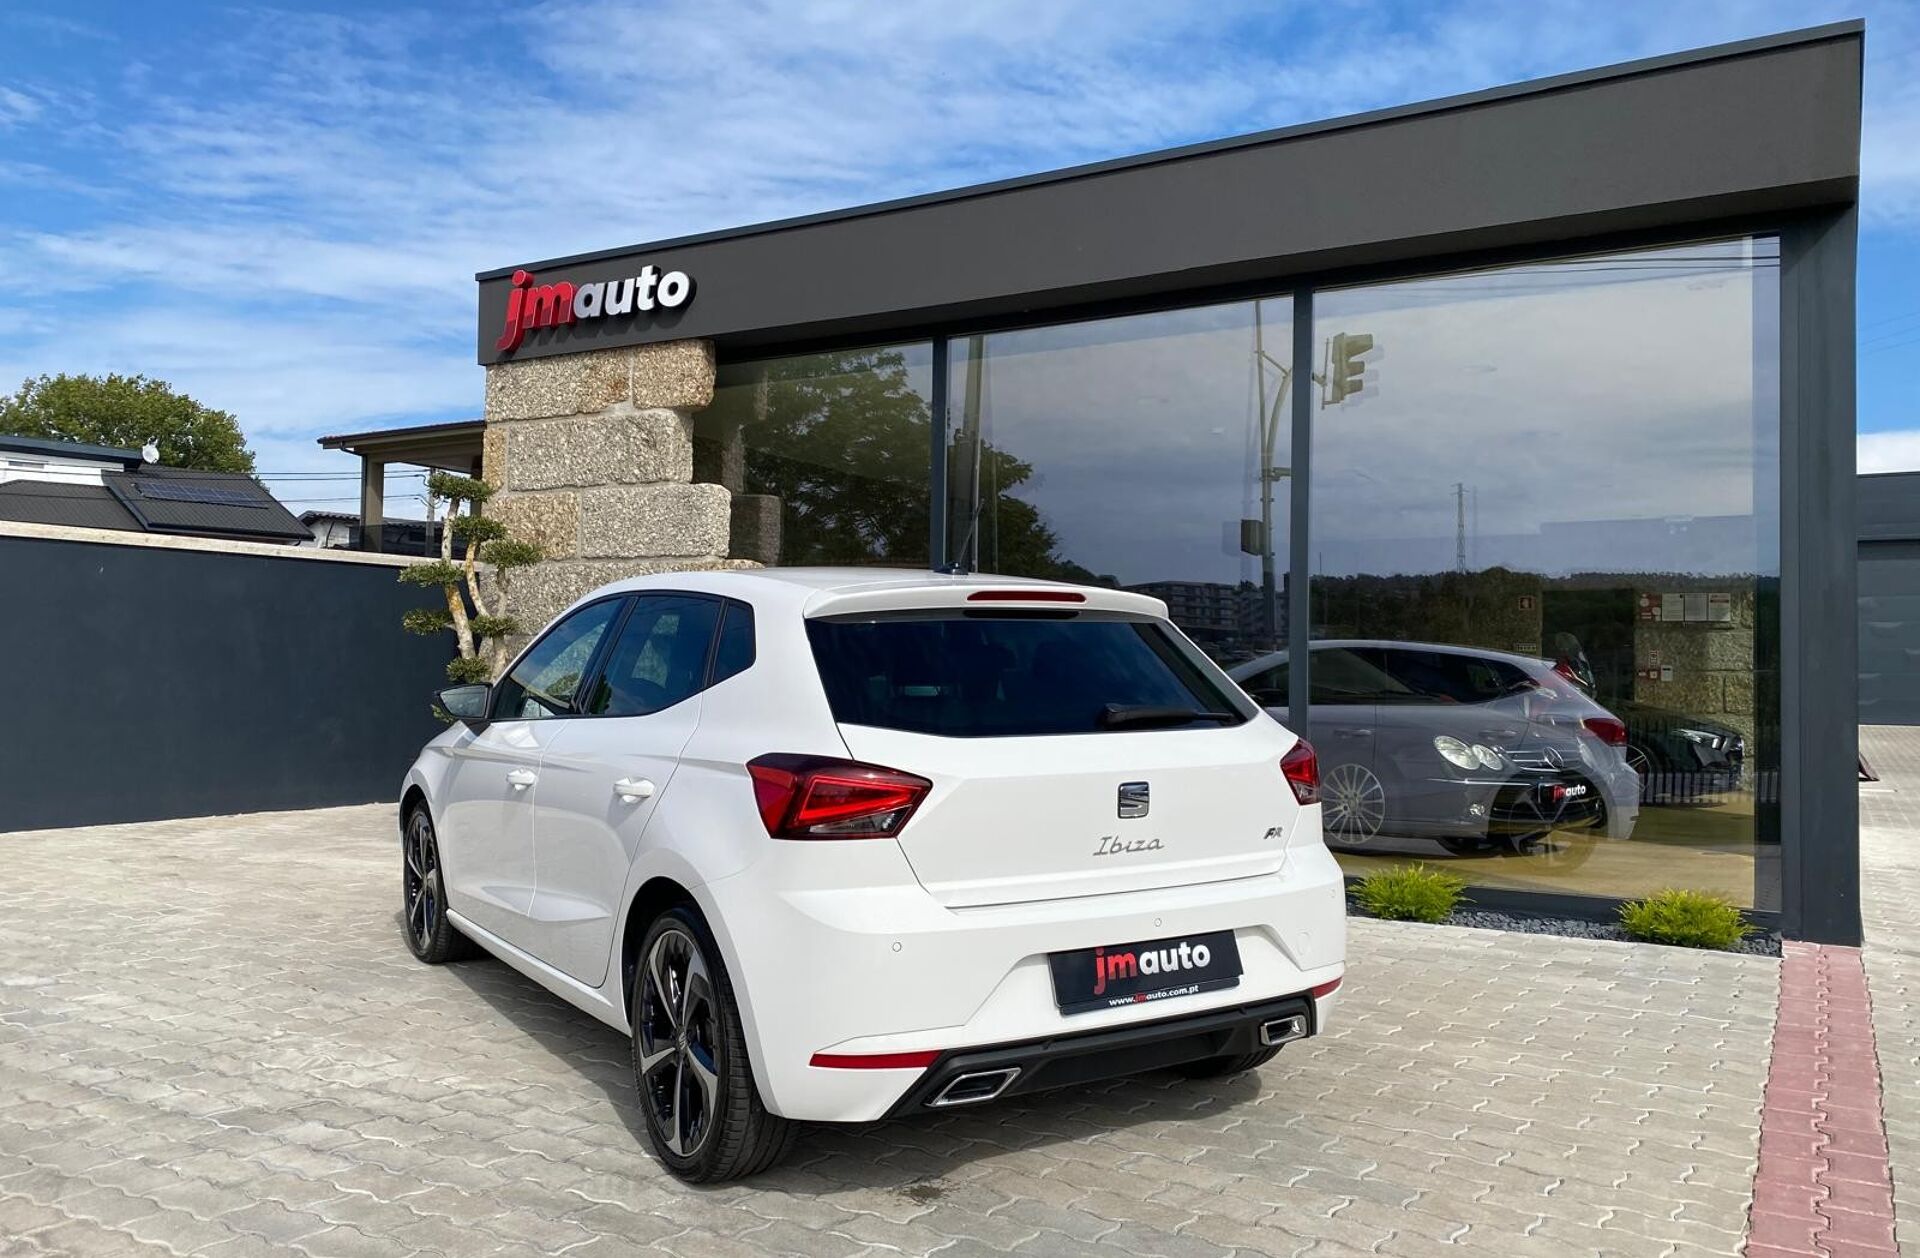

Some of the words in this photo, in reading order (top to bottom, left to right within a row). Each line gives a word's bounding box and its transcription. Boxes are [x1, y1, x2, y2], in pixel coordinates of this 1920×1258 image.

[496, 265, 693, 352] jmauto
[1093, 835, 1165, 856] Ibiza
[1093, 941, 1211, 994] jmauto
[1108, 984, 1199, 1007] www.jmauto.com.pt
